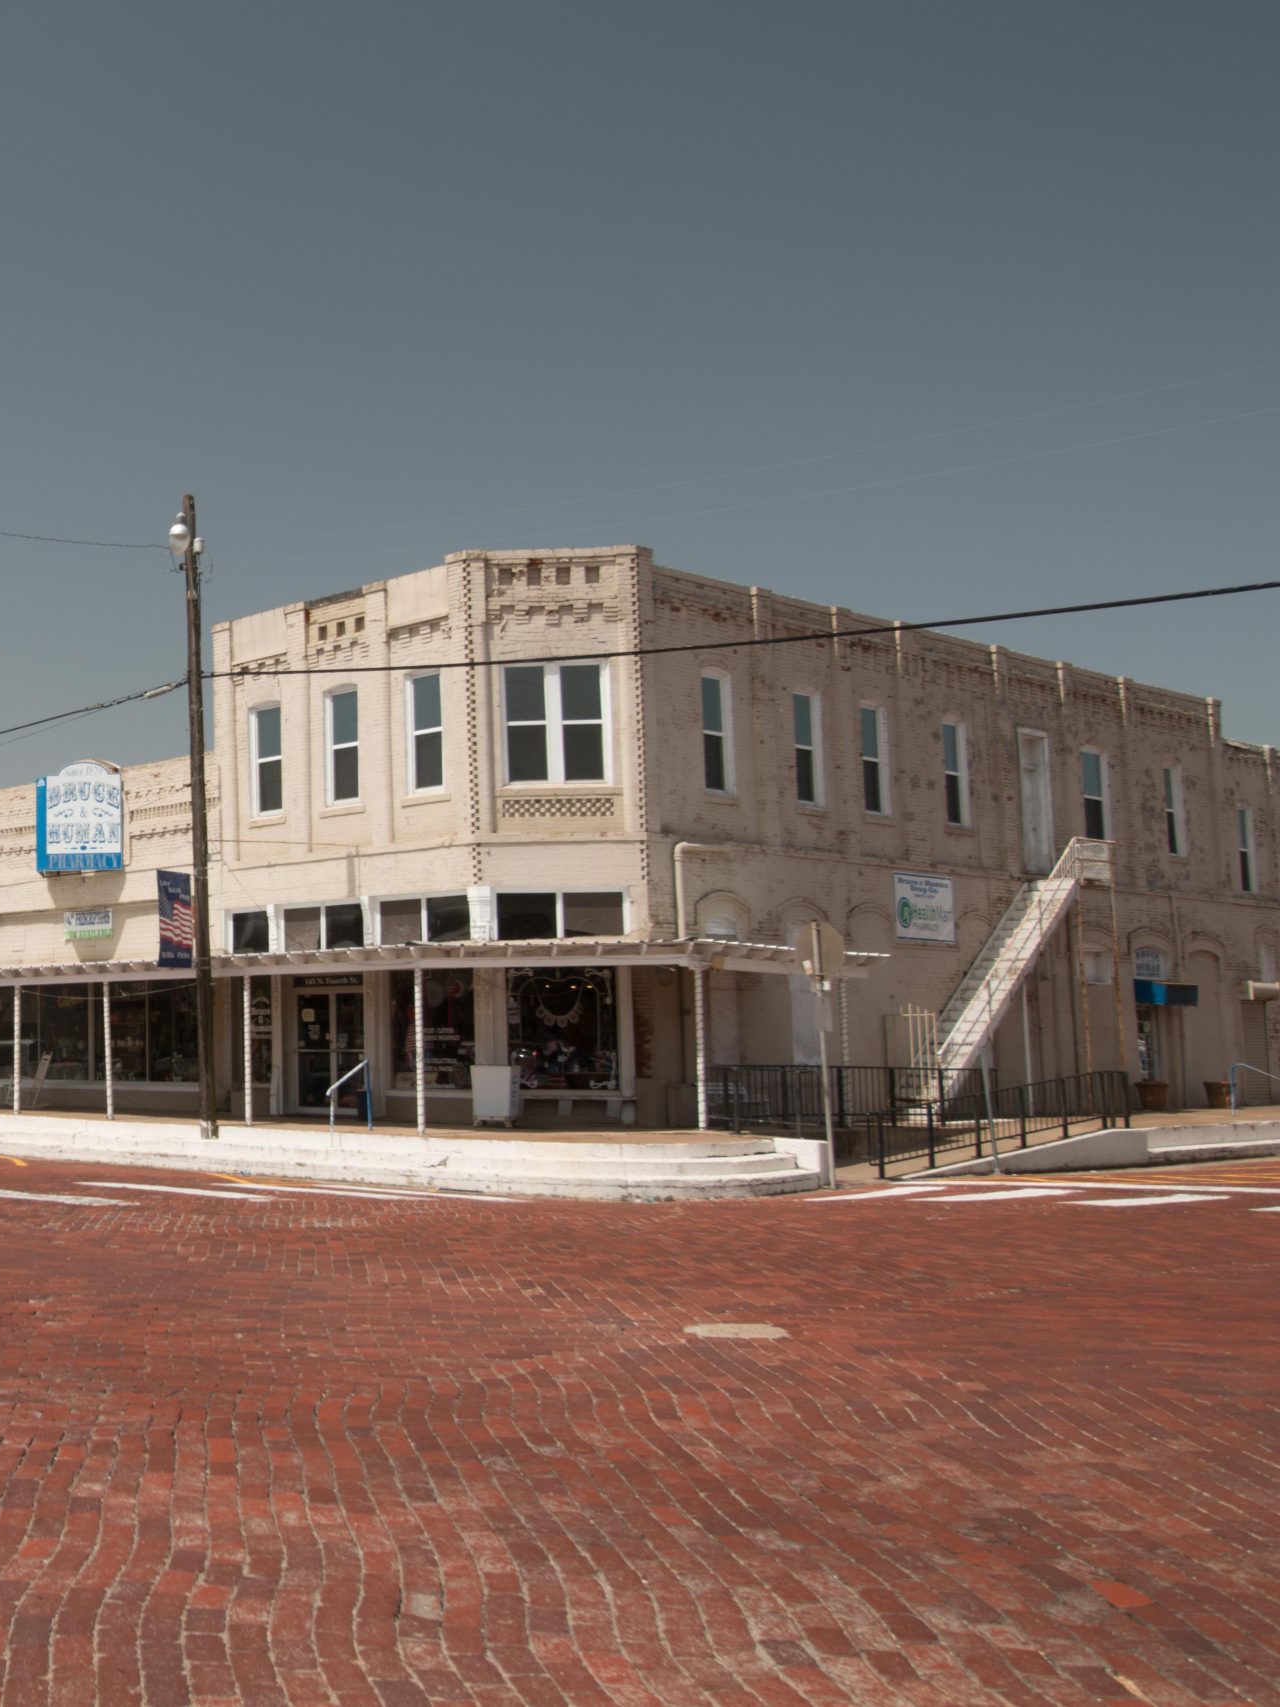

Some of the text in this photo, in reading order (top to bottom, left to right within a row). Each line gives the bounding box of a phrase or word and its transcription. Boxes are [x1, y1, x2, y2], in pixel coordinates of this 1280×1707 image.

[47, 781, 120, 809] BRUCE
[80, 806, 87, 817] &
[47, 822, 120, 844] HUMAN
[48, 853, 120, 869] PHARMACY
